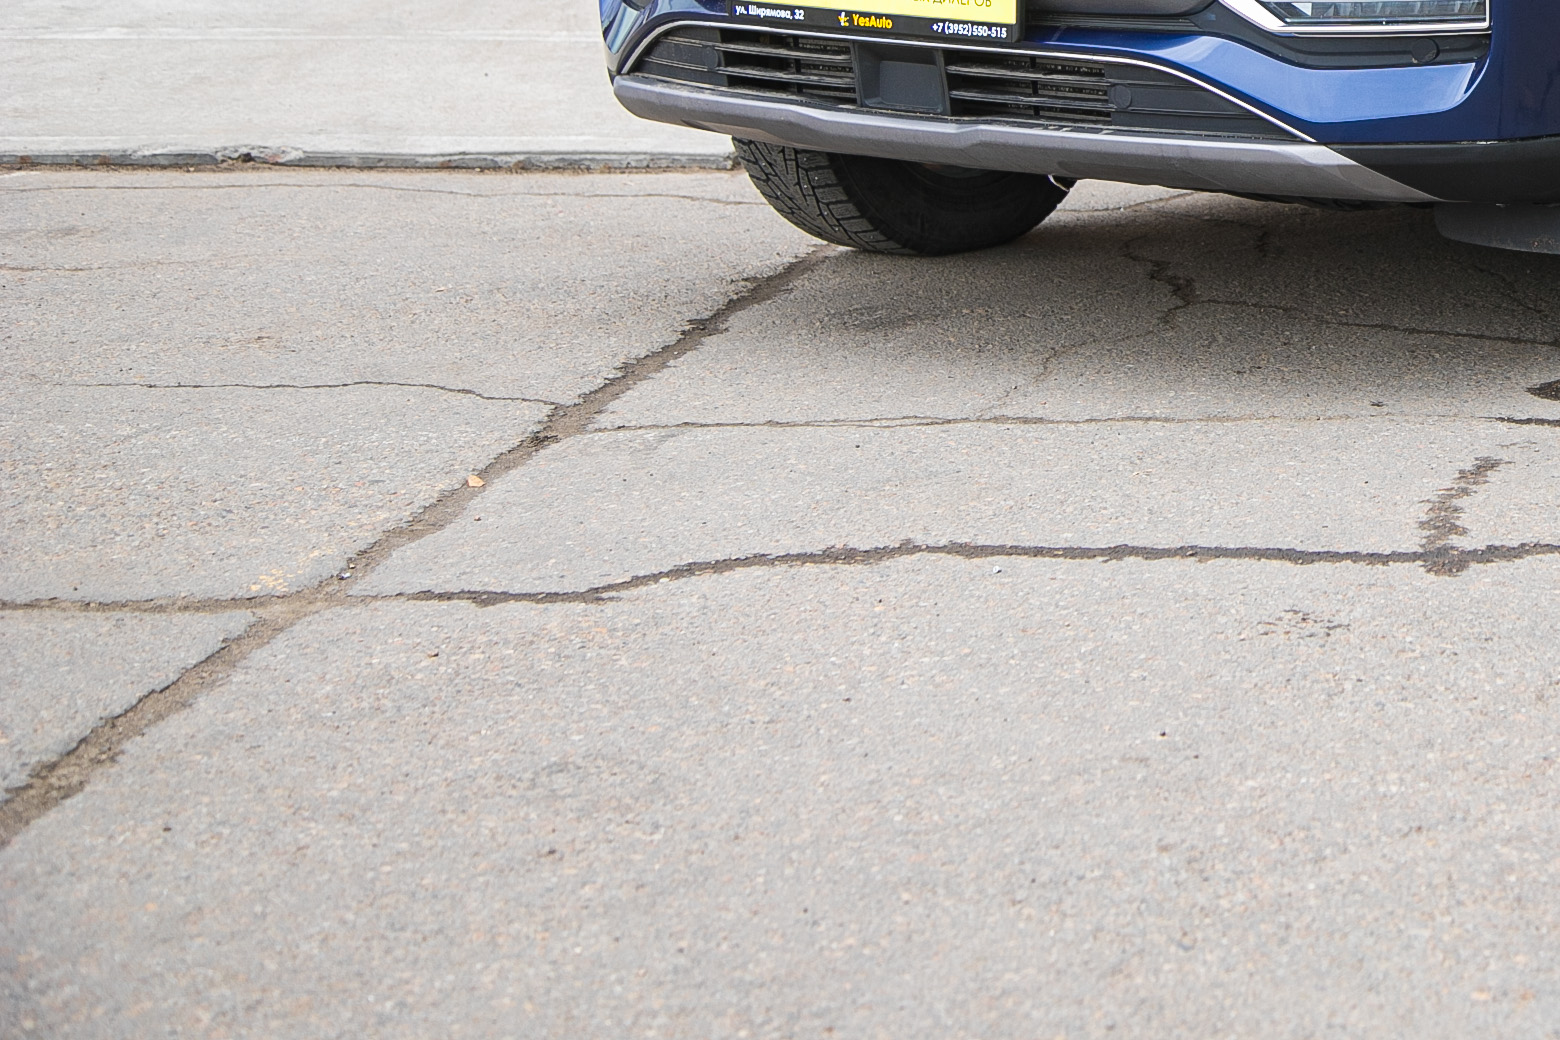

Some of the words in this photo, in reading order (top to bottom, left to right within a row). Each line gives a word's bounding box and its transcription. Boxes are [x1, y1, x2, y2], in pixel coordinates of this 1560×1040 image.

[735, 5, 747, 16] ул.
[794, 9, 805, 20] 32
[852, 13, 893, 29] YesAuto
